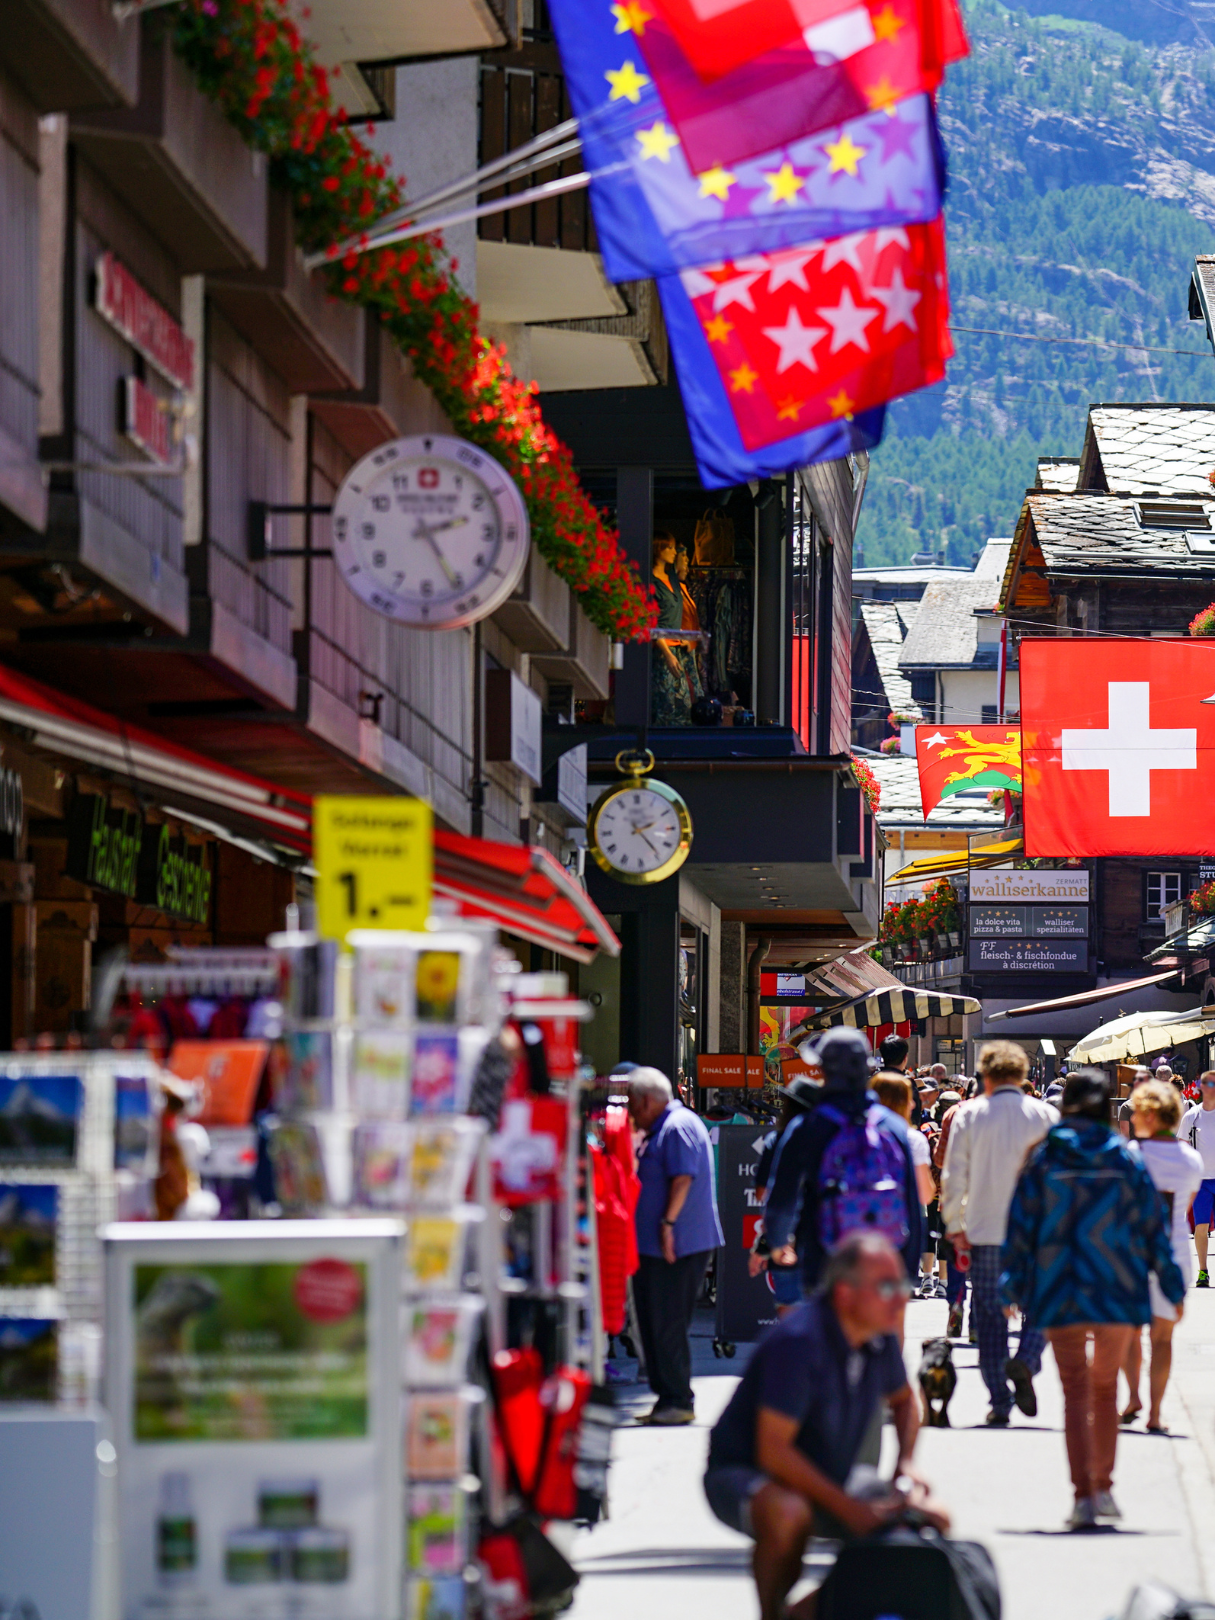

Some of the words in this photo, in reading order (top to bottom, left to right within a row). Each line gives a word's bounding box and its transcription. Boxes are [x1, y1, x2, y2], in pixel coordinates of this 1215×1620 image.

[971, 883, 1088, 897] walliserkanne
[975, 918, 984, 926] la
[985, 918, 1004, 926] dolce
[1006, 918, 1021, 926] vita
[1044, 918, 1075, 926] walliser
[973, 926, 994, 934] pizza
[1002, 926, 1023, 934] pasta
[1036, 926, 1084, 934] spezialitäten
[980, 951, 1014, 960] fleisch-
[1016, 951, 1022, 960] &
[1024, 951, 1077, 960] fischfondue
[1010, 961, 1055, 969] discrétion
